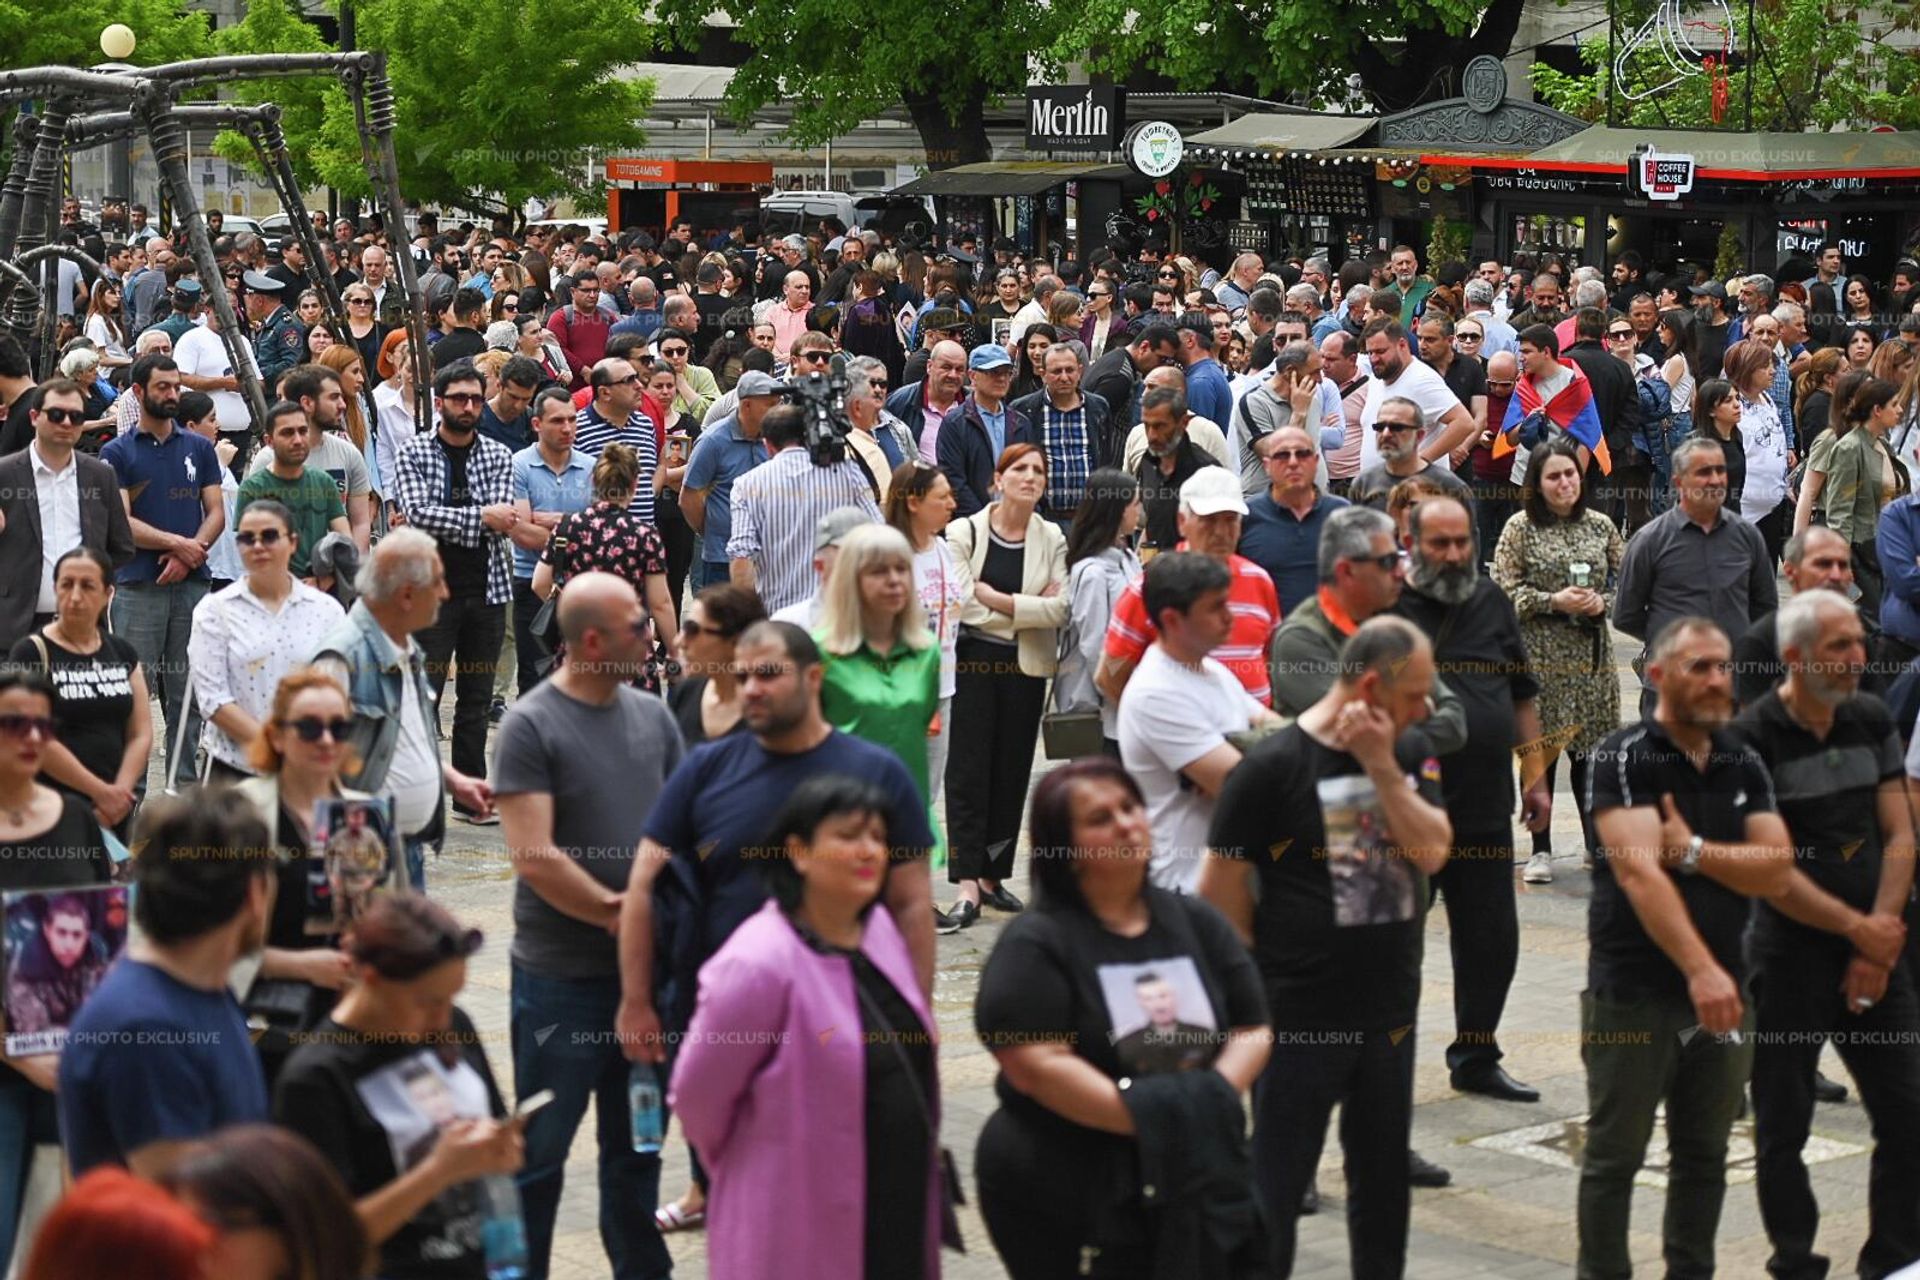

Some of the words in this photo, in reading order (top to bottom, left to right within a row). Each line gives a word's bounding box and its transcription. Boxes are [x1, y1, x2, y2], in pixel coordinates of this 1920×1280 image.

[1031, 88, 1108, 137] Merlin
[615, 164, 663, 177] TOTOGAMING
[1657, 163, 1687, 173] COFFEE
[1657, 174, 1683, 183] HOUSE
